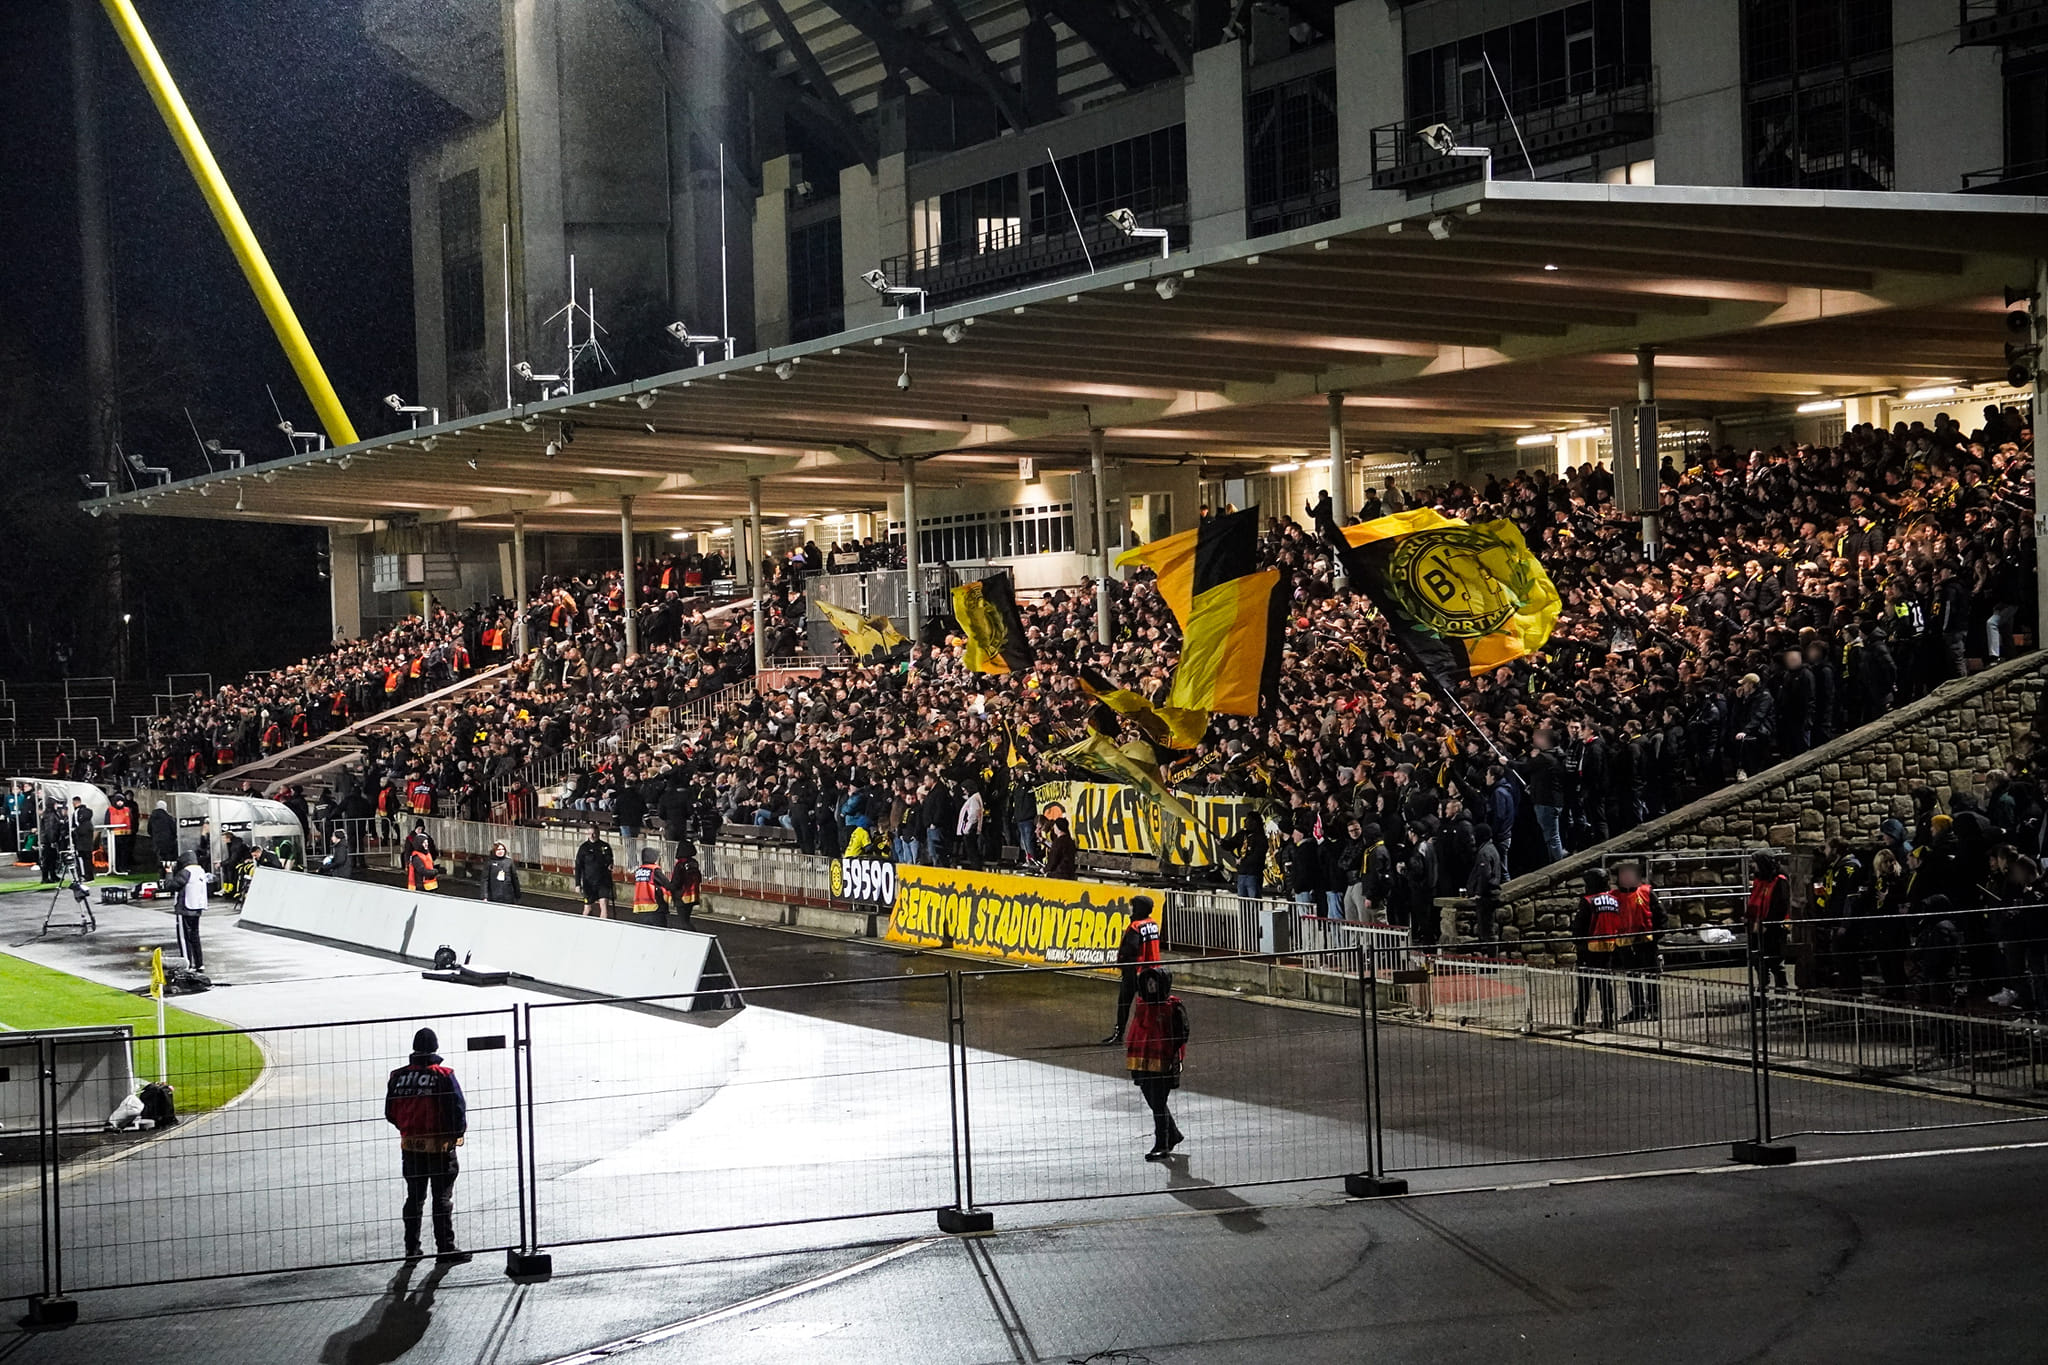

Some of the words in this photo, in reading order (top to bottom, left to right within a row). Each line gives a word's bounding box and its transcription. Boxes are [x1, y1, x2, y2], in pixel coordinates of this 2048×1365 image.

[842, 858, 894, 905] 59590
[897, 887, 972, 940] SEKTION
[1594, 894, 1619, 907] atlas
[396, 1071, 438, 1087] atlas
